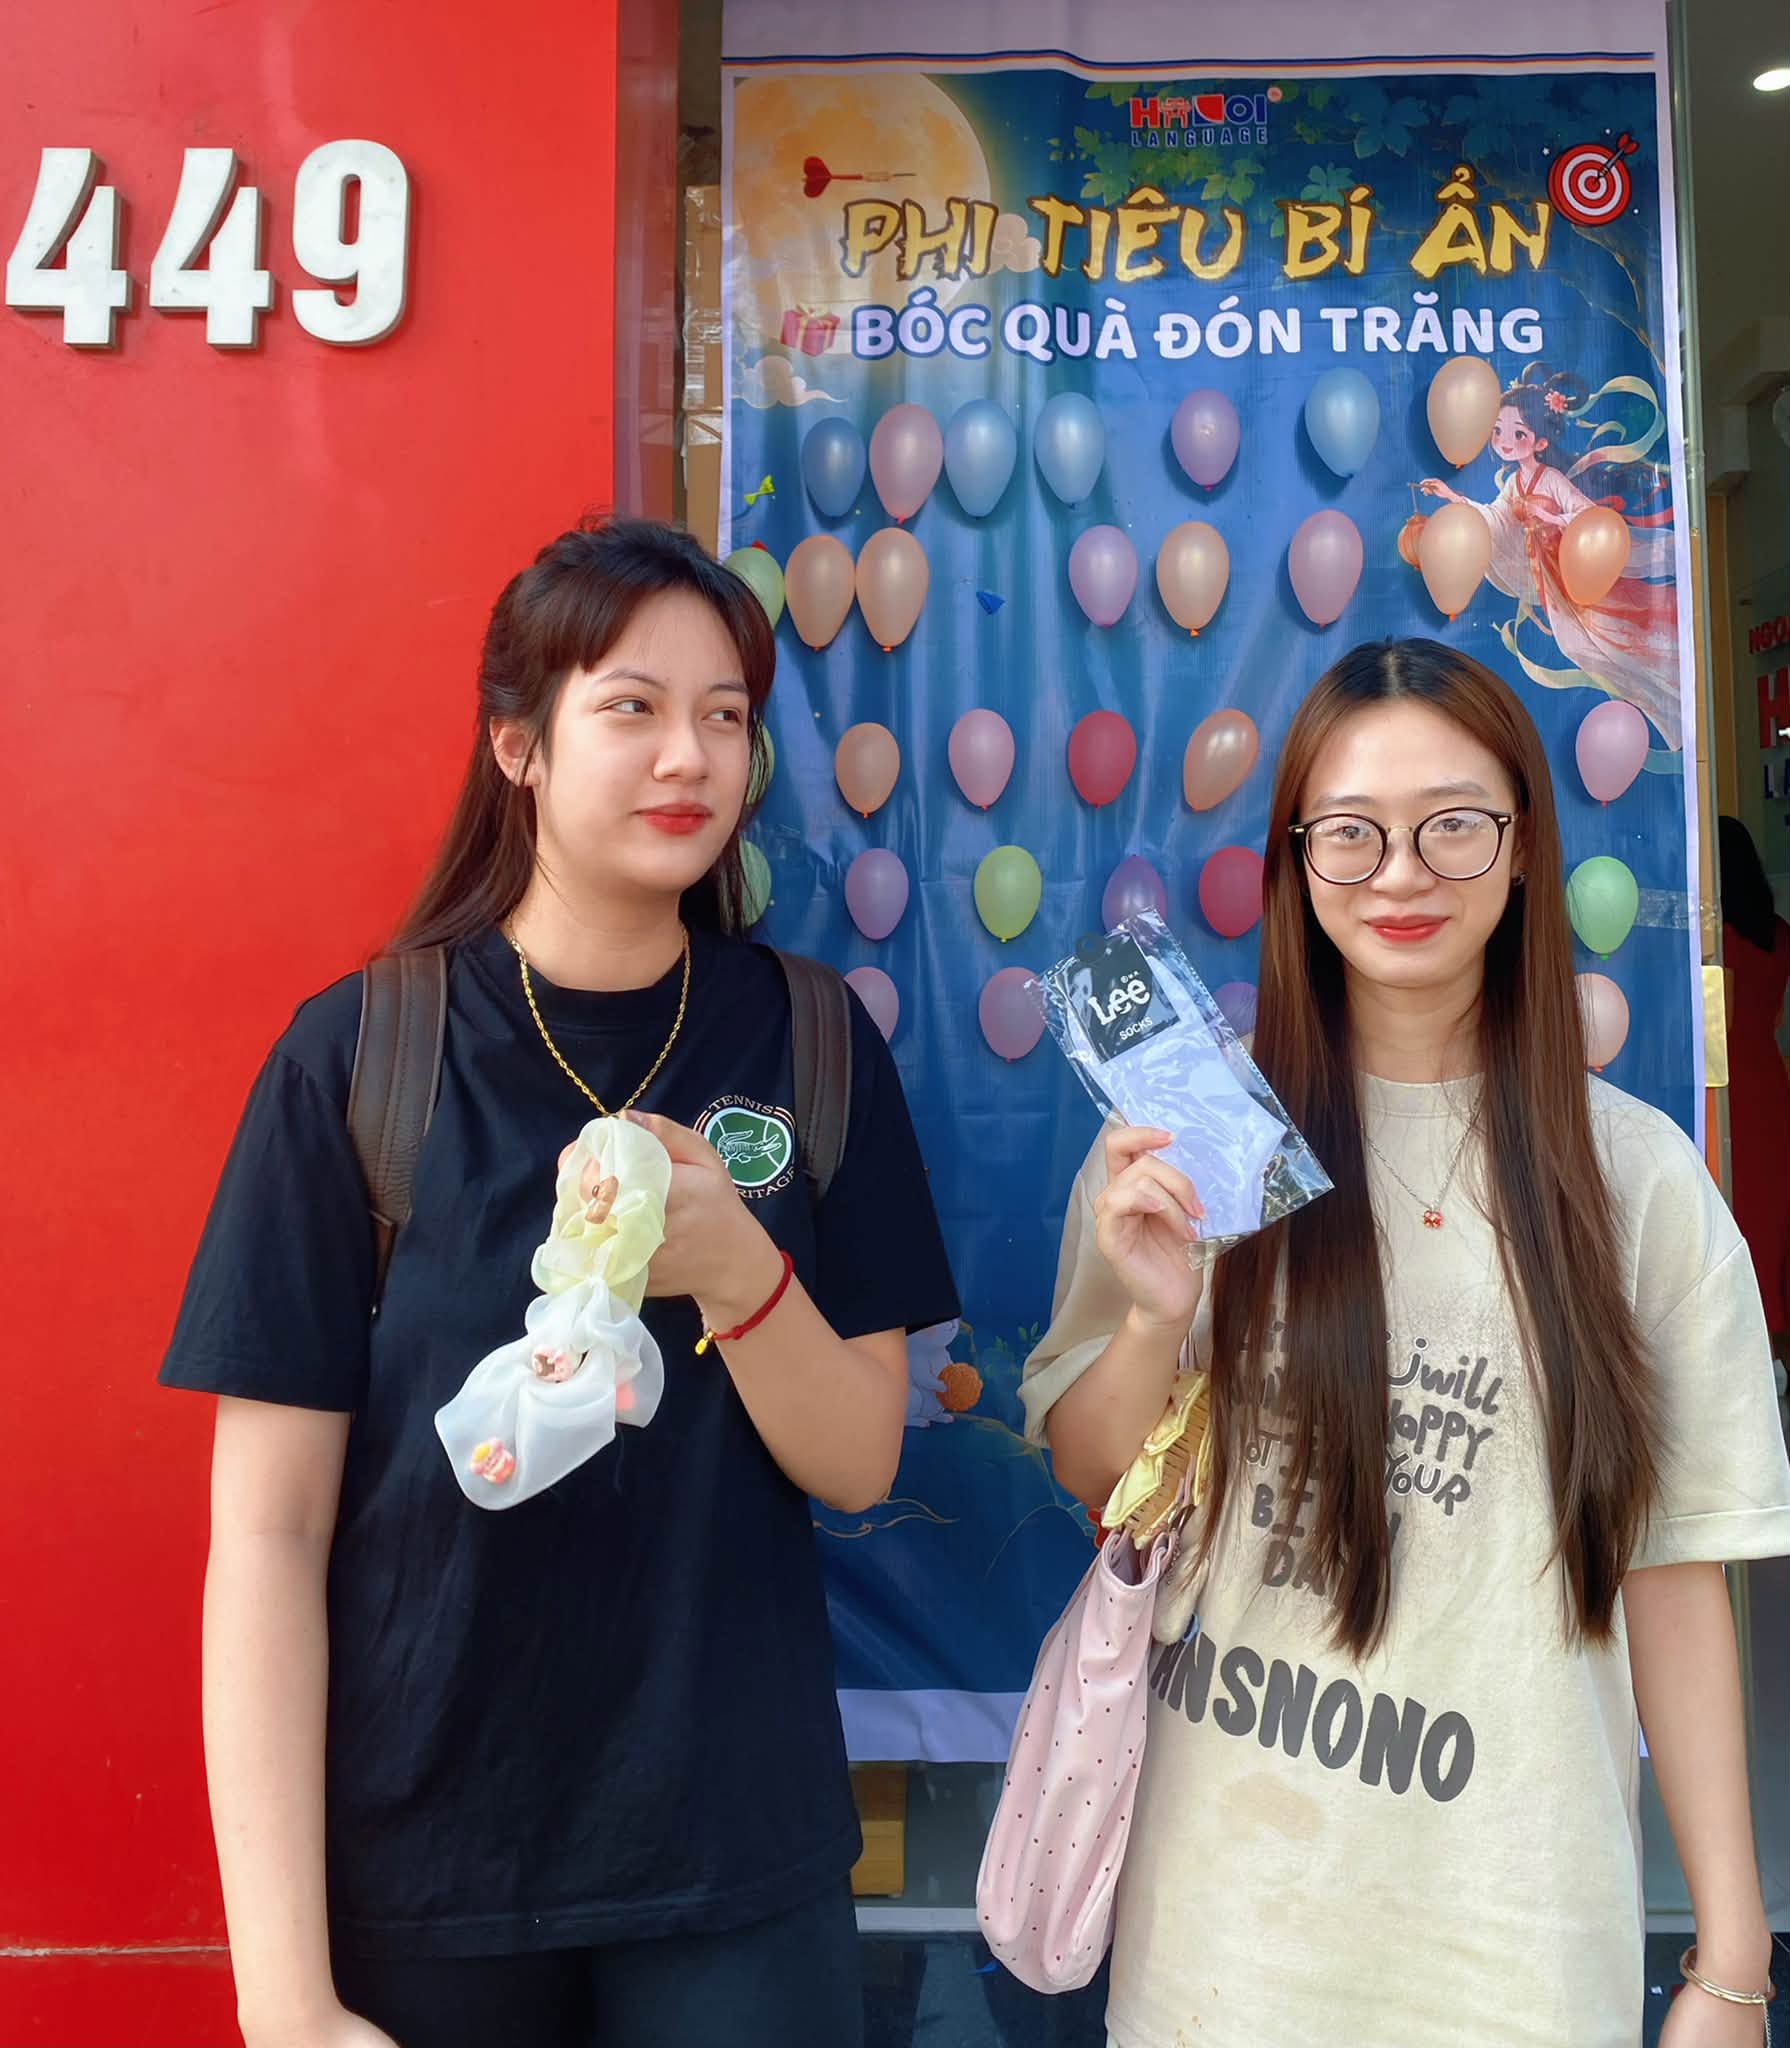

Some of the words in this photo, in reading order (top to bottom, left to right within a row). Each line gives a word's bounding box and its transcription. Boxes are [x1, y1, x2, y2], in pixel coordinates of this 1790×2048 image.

[1131, 127, 1268, 148] LANGUAGE
[5, 138, 411, 347] 449
[840, 197, 998, 282] PHI
[1028, 185, 1248, 284] TIÊU
[1280, 184, 1374, 282] BÍ
[1408, 163, 1553, 281] ẨN
[853, 287, 991, 359] BÓC
[1003, 298, 1138, 362] QUÀ
[1153, 296, 1301, 359] ĐÓN
[1319, 291, 1544, 354] TRĂNG
[1088, 979, 1151, 1026] Lee
[1119, 1016, 1153, 1041] SOCKS
[708, 1094, 775, 1115] TENNIS
